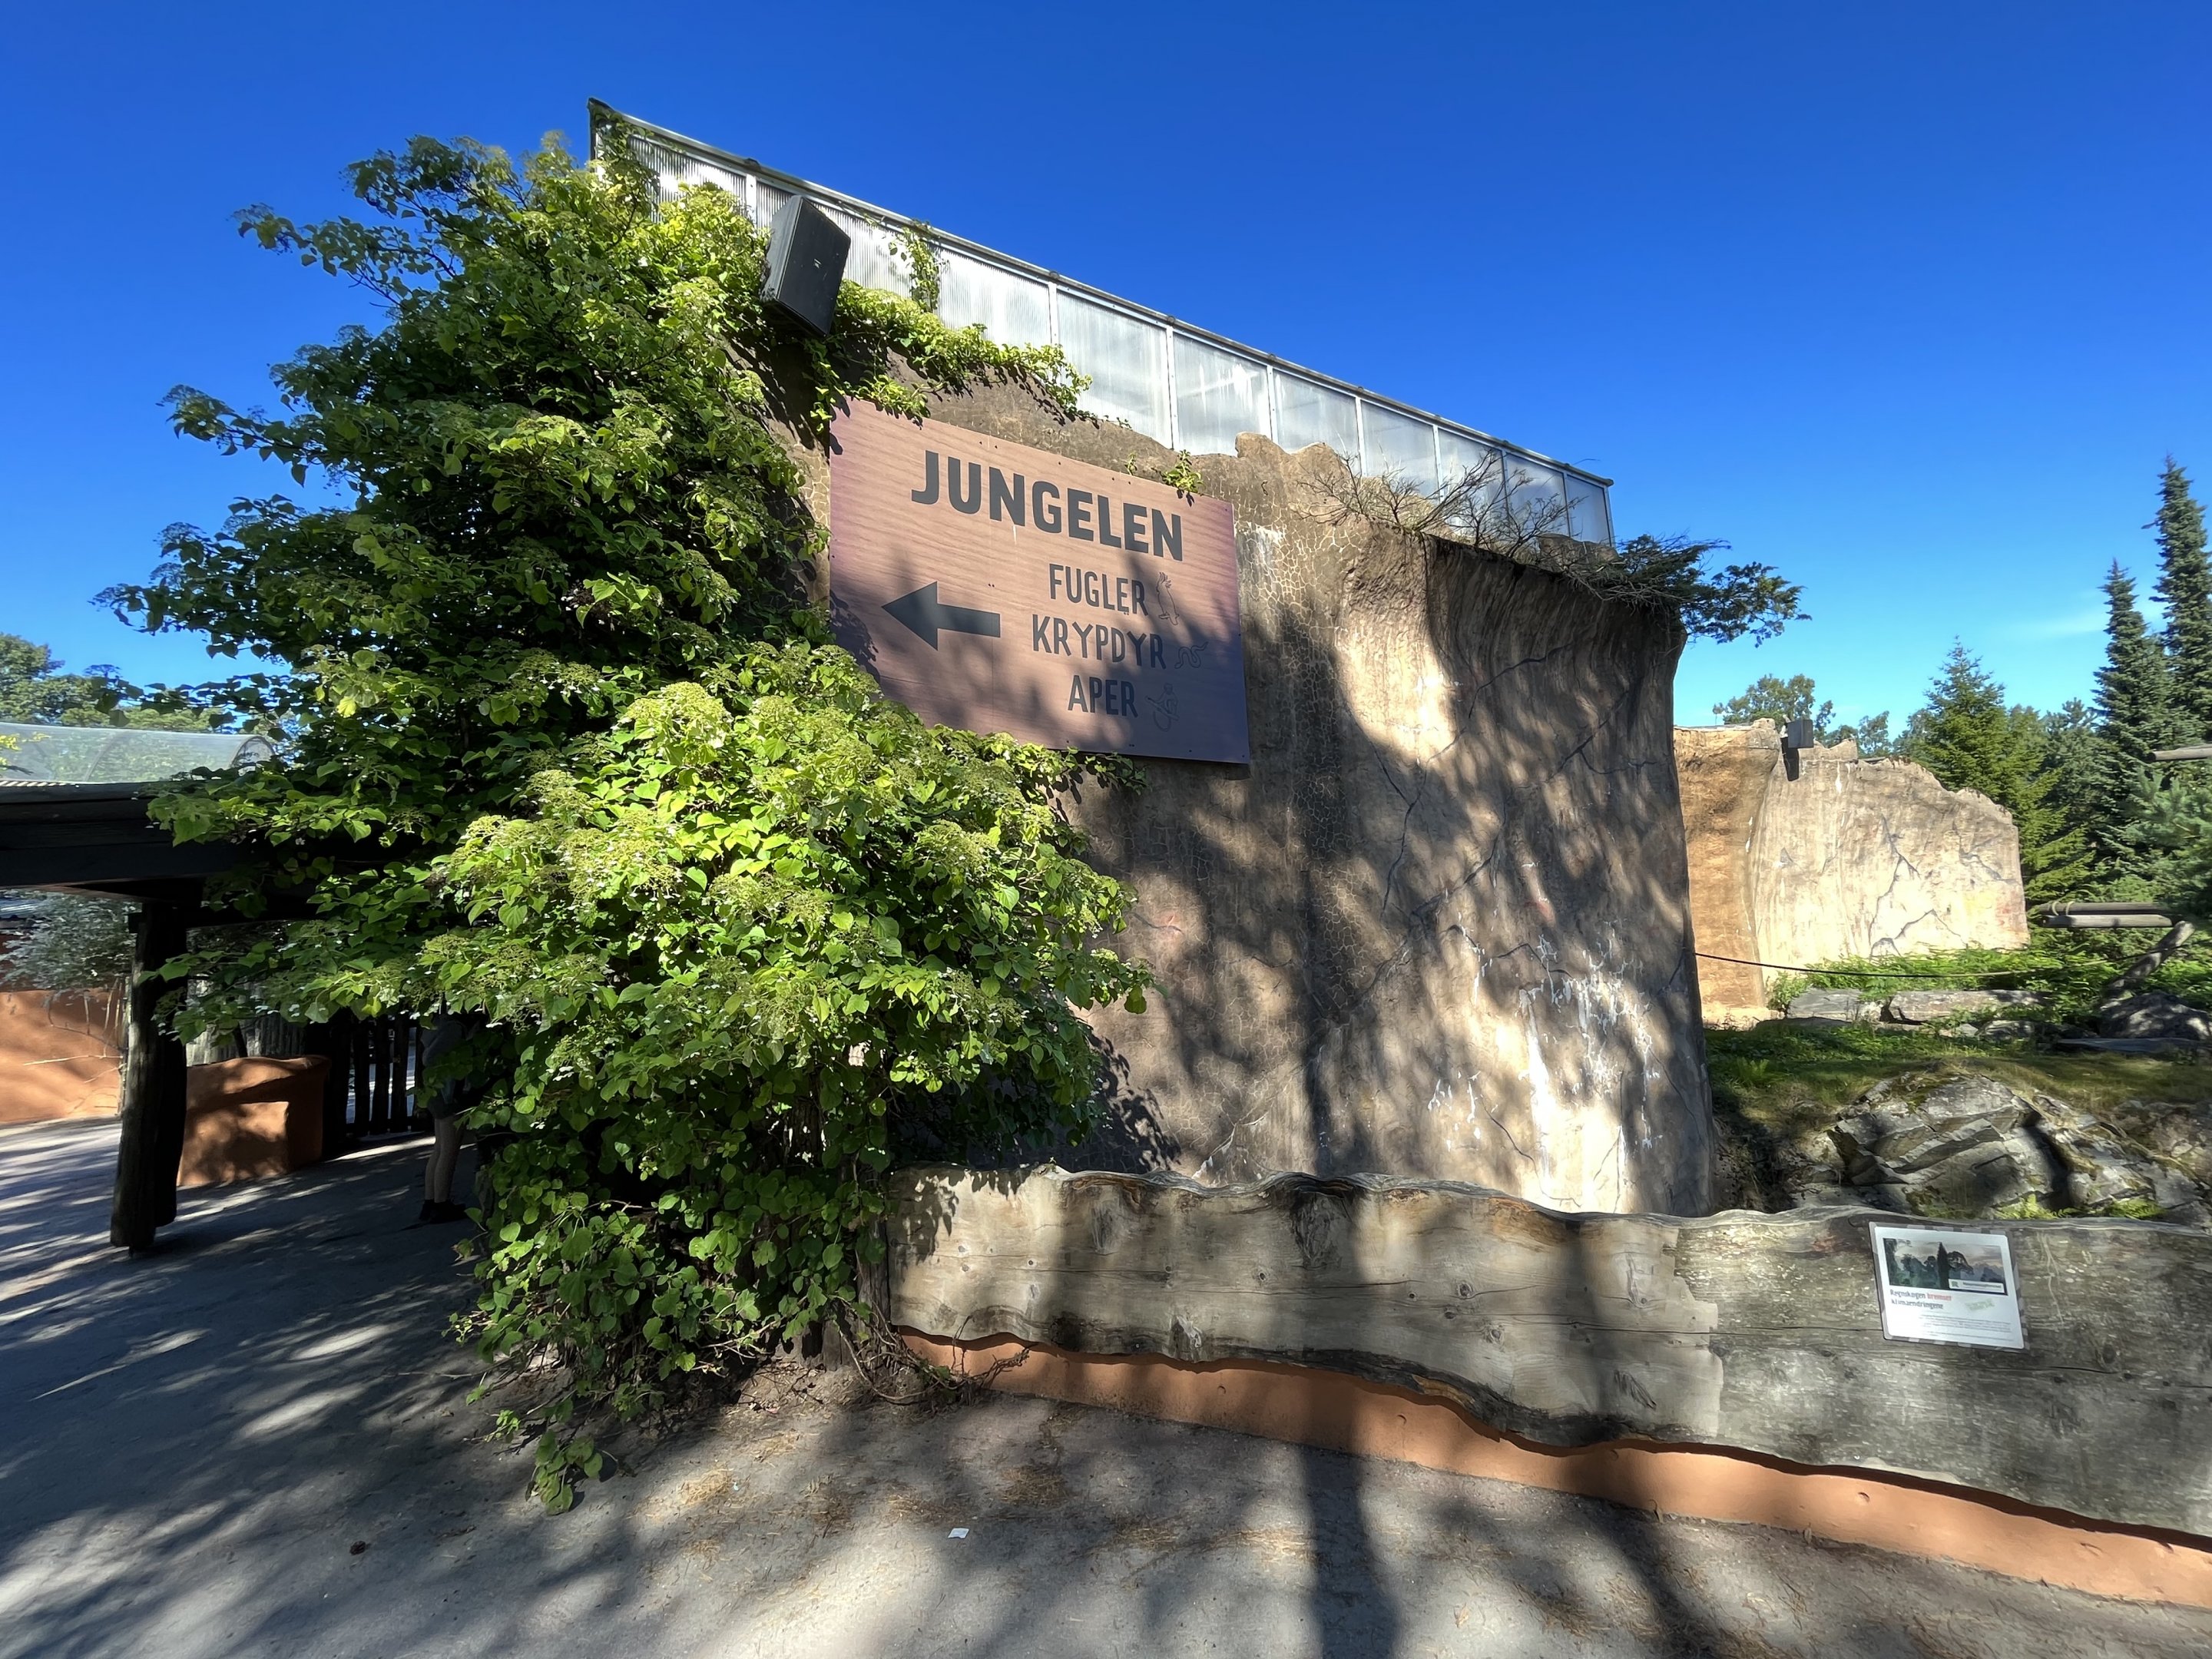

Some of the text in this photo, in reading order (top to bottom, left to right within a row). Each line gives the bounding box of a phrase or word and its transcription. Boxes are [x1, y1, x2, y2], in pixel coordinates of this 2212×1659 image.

[911, 450, 1184, 561] JUNGELEN
[1049, 563, 1148, 616] FUGLER
[1032, 614, 1167, 670] KRYPDYR
[1068, 675, 1138, 717] APER
